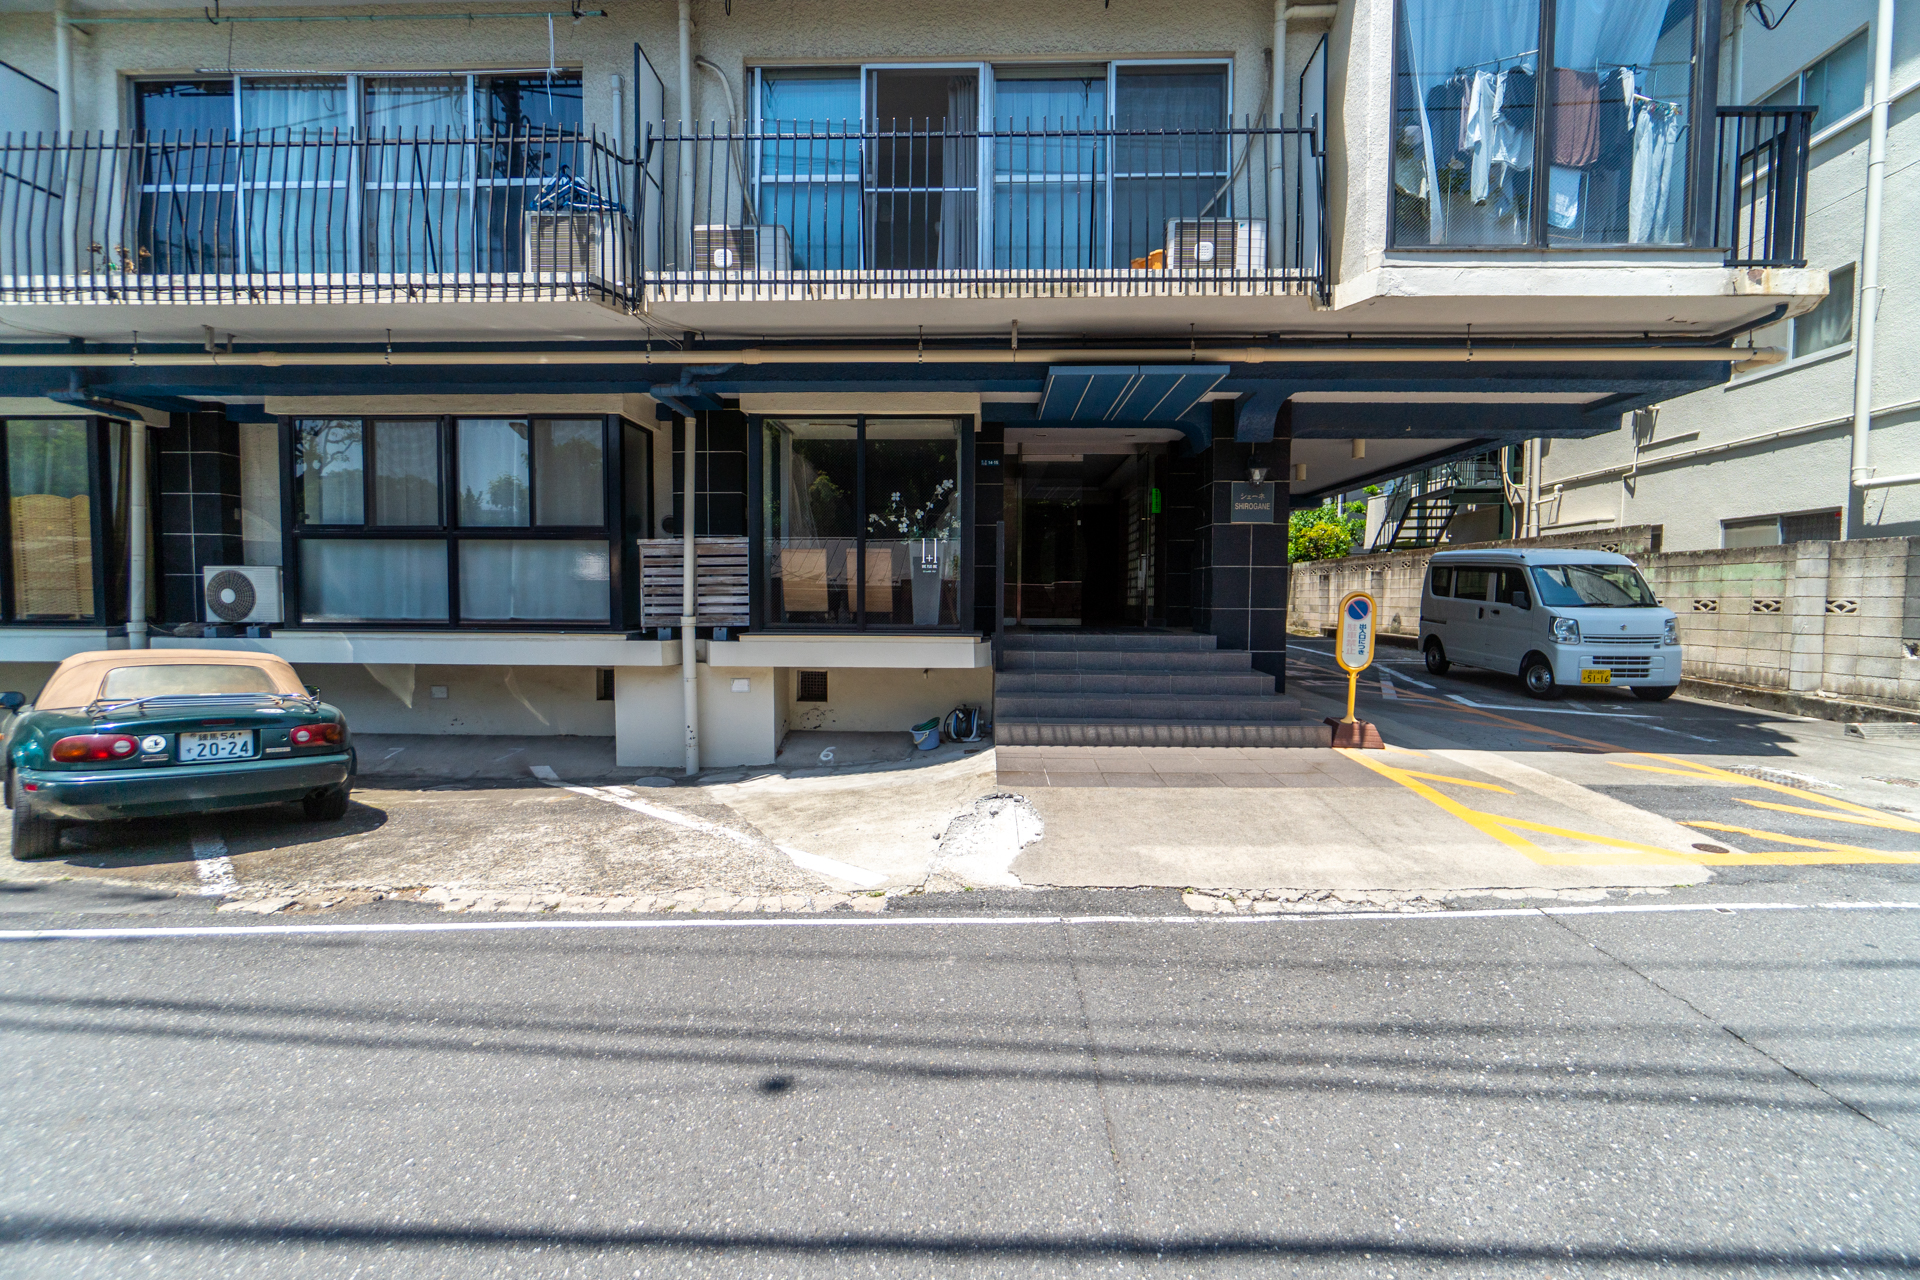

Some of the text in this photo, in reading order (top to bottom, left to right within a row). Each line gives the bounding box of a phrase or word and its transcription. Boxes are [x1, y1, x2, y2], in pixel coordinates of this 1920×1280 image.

[1240, 492, 1266, 500] シェーネ
[1234, 502, 1271, 510] SHIROGANE
[1346, 623, 1357, 655] 駐車禁止
[1358, 623, 1367, 656] 出入口につき
[197, 740, 249, 757] 20-24
